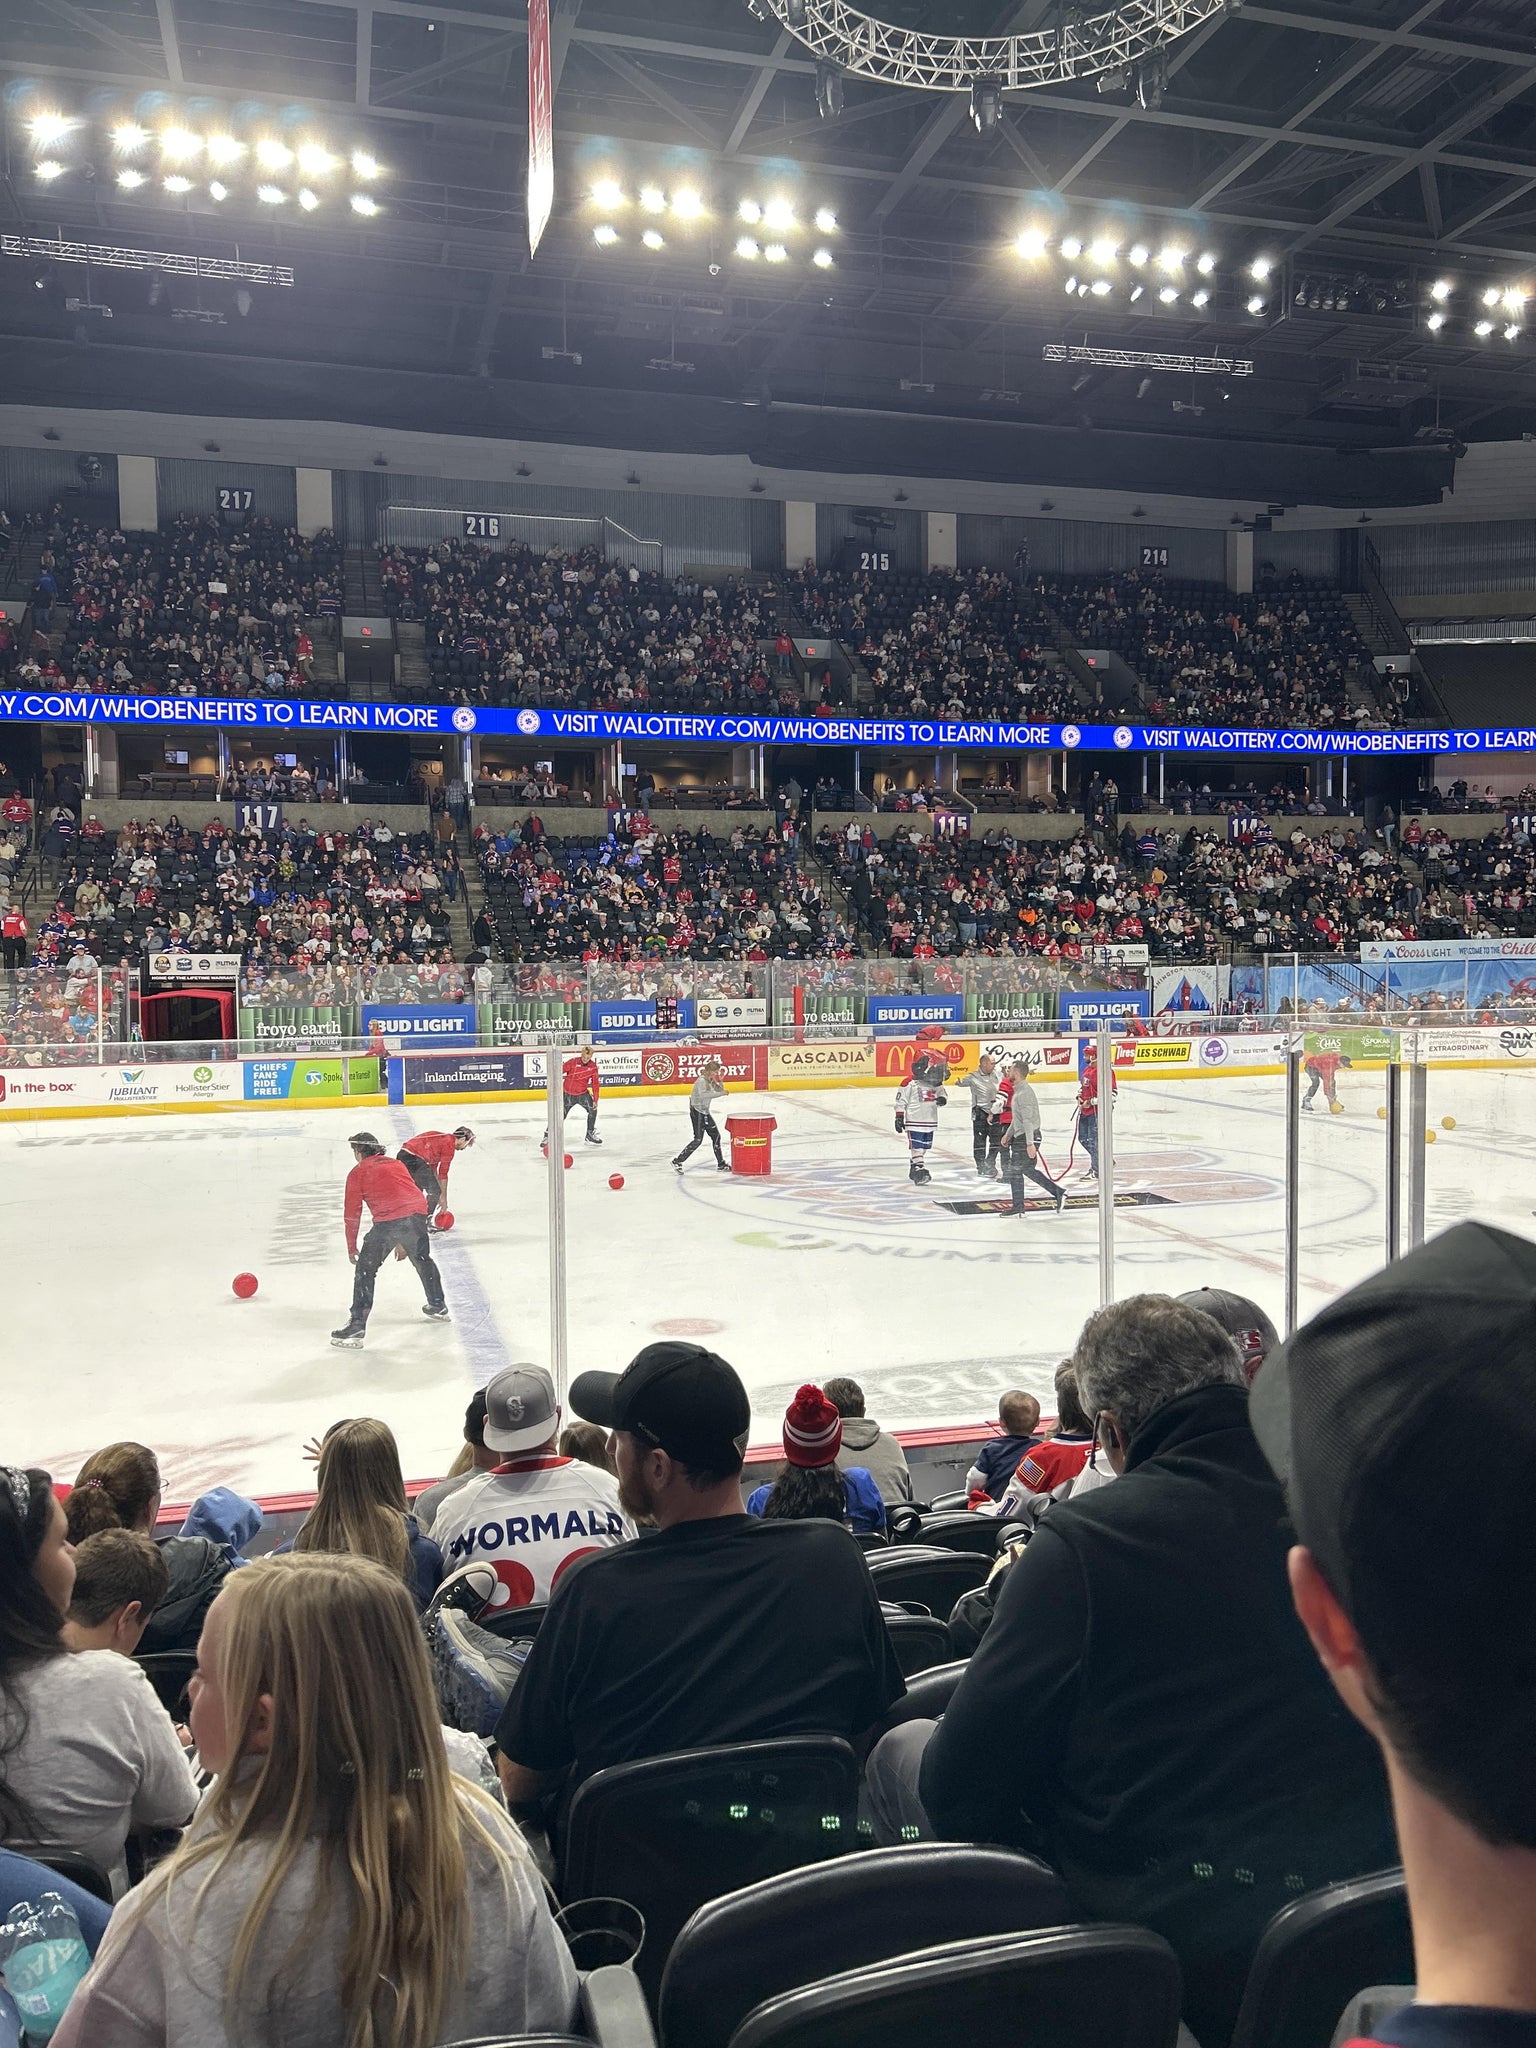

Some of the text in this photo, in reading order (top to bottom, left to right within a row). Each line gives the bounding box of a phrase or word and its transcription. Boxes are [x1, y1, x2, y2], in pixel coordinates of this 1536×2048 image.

[220, 489, 253, 510] 217
[466, 516, 499, 537] 216
[860, 552, 890, 572] 215
[1143, 548, 1168, 566] 214
[0, 695, 257, 721] Y.COM/WHOBENEFITS
[262, 703, 294, 723] TO
[300, 704, 368, 726] LEARN
[375, 708, 438, 727] MORE
[552, 714, 598, 733] VISIT
[603, 715, 905, 742] WALOTTERY.COM/WHOBENEFITS
[909, 724, 934, 742] TO
[939, 725, 993, 743] LEARN
[999, 726, 1050, 744] MORE
[1143, 729, 1180, 747] VISIT
[1184, 730, 1450, 752] WALOTTERY.COM/WHOBENEFITS
[1454, 732, 1480, 749] TO
[241, 805, 277, 829] 117
[938, 816, 968, 836] 115
[1395, 944, 1425, 959] Coors
[1427, 948, 1451, 958] LIGHT
[1483, 946, 1490, 955] TO
[1491, 945, 1500, 954] THE
[878, 1007, 953, 1021] BUD LIGHT
[1068, 1003, 1140, 1016] BUD LIGHT
[601, 1014, 684, 1028] BUD LIT
[784, 1009, 855, 1033] fryo earth
[978, 1005, 1044, 1030] froyo earth
[377, 1018, 465, 1033] BUD LIGHT
[494, 1017, 532, 1042] froyo
[537, 1015, 574, 1030] earth
[256, 1021, 297, 1048] froyo
[300, 1020, 342, 1036] earth
[1115, 1044, 1136, 1060] Tires
[1137, 1047, 1187, 1058] LES SCHWAB
[1428, 1044, 1489, 1052] EXTRAORDINARY
[612, 1056, 639, 1064] Office
[678, 1054, 723, 1066] PIZZA
[781, 1051, 865, 1065] CASCADIA
[253, 1063, 287, 1072] CHIEFS
[678, 1065, 748, 1078] FACORY
[253, 1071, 278, 1080] FANS
[10, 1082, 74, 1093] in the box
[253, 1080, 276, 1088] RIDE
[109, 1086, 159, 1101] JUBILANT
[253, 1088, 282, 1096] FREE!
[836, 1242, 1218, 1264] NUMERCA
[450, 1510, 624, 1558] WORMALD
